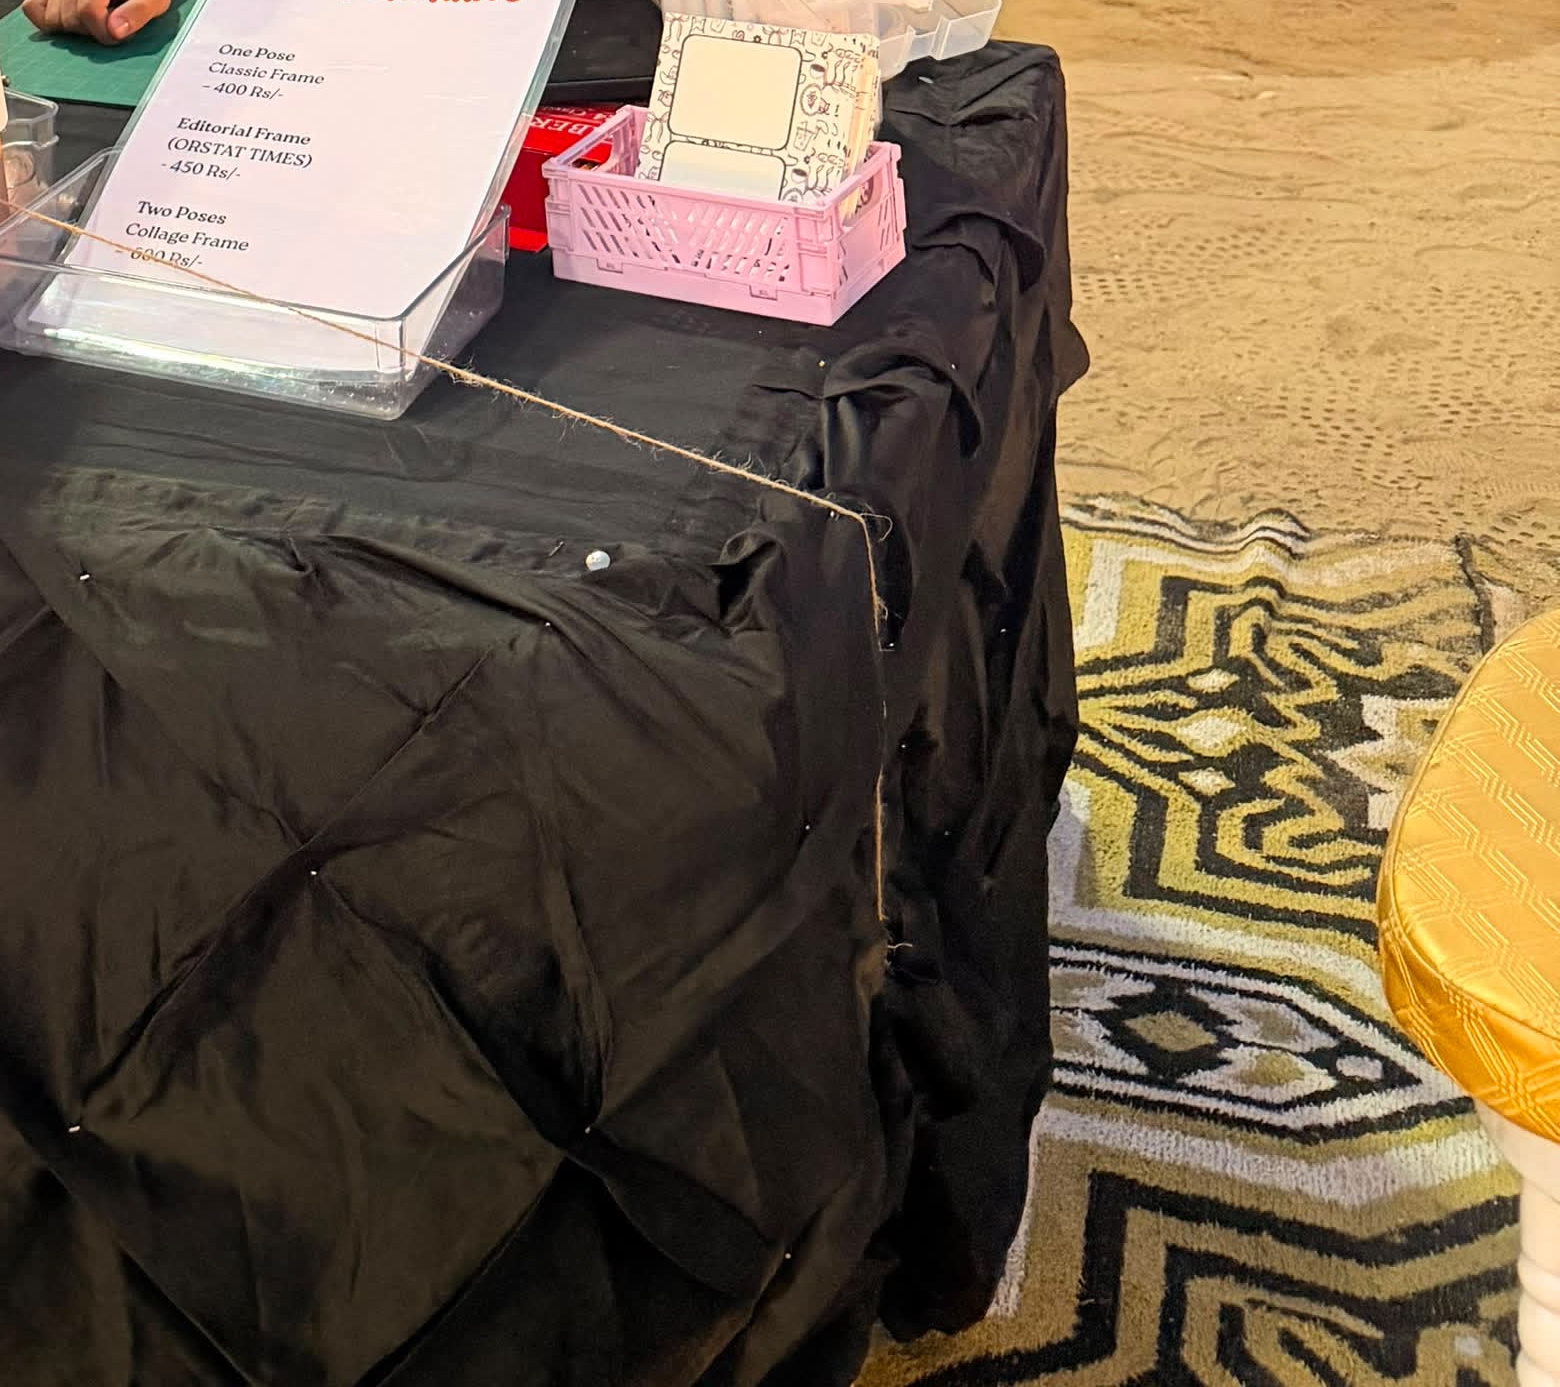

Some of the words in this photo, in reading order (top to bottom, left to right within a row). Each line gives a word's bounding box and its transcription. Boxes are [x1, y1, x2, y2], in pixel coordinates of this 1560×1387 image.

[218, 43, 253, 59] One
[255, 47, 296, 62] Pose
[208, 61, 268, 80] Classic
[269, 68, 325, 85] Frame
[213, 82, 247, 96] 400
[249, 85, 284, 101] Rs/-
[176, 117, 253, 139] Editorial
[254, 127, 312, 146] Frame
[167, 136, 247, 159] (ORSTAT
[249, 146, 313, 169] TIMES)
[170, 159, 205, 176] 450
[205, 166, 241, 180] Rs/-
[137, 200, 173, 218] Two
[174, 205, 228, 225] Poses
[125, 222, 190, 245] Collage
[191, 231, 250, 252] Frame
